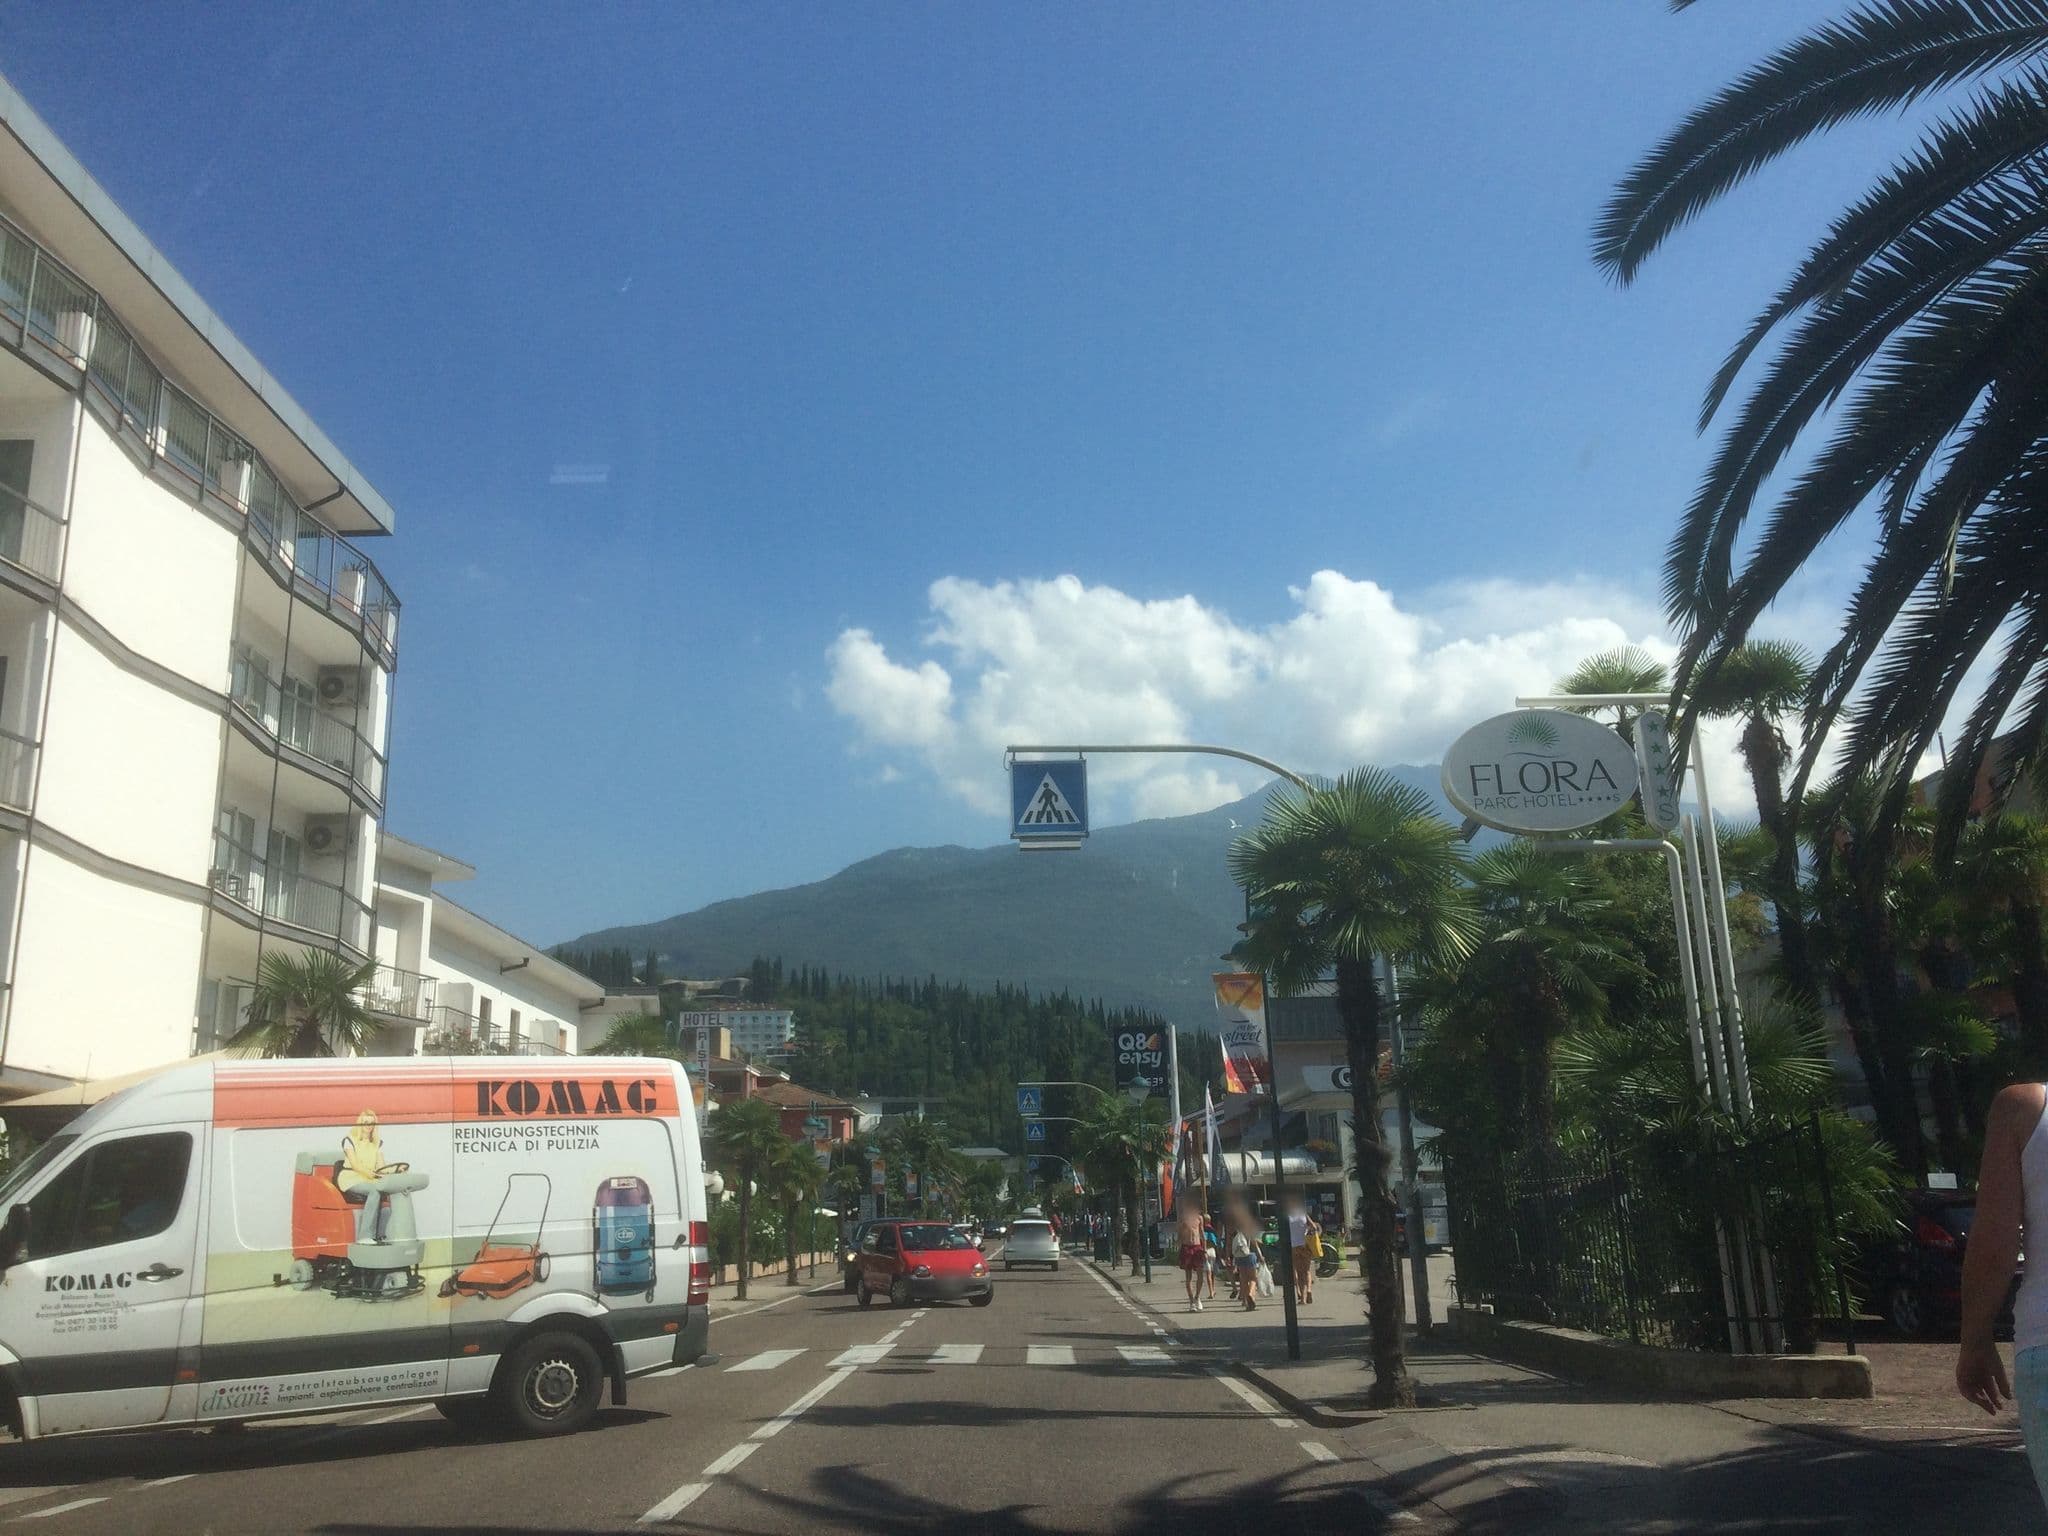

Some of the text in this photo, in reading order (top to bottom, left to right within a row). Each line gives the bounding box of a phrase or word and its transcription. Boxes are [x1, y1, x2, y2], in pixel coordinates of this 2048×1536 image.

[1470, 759, 1618, 796] FLORA
[1474, 796, 1518, 810] PARC
[1524, 794, 1577, 808] HOTEL
[1658, 803, 1676, 822] S
[684, 1013, 724, 1026] HOTEL
[1119, 1033, 1146, 1050] Q8
[1224, 1028, 1262, 1042] street
[1119, 1051, 1162, 1067] easy
[478, 1079, 657, 1116] KOMAG
[455, 1125, 600, 1139] REINIGUNGSTECHNIK
[455, 1138, 600, 1153] TECNICA DI PULIZIA
[45, 1272, 132, 1292] KOMAG
[278, 1369, 439, 1392] Zentralstaubsauganlagen
[277, 1391, 314, 1403] Impianti
